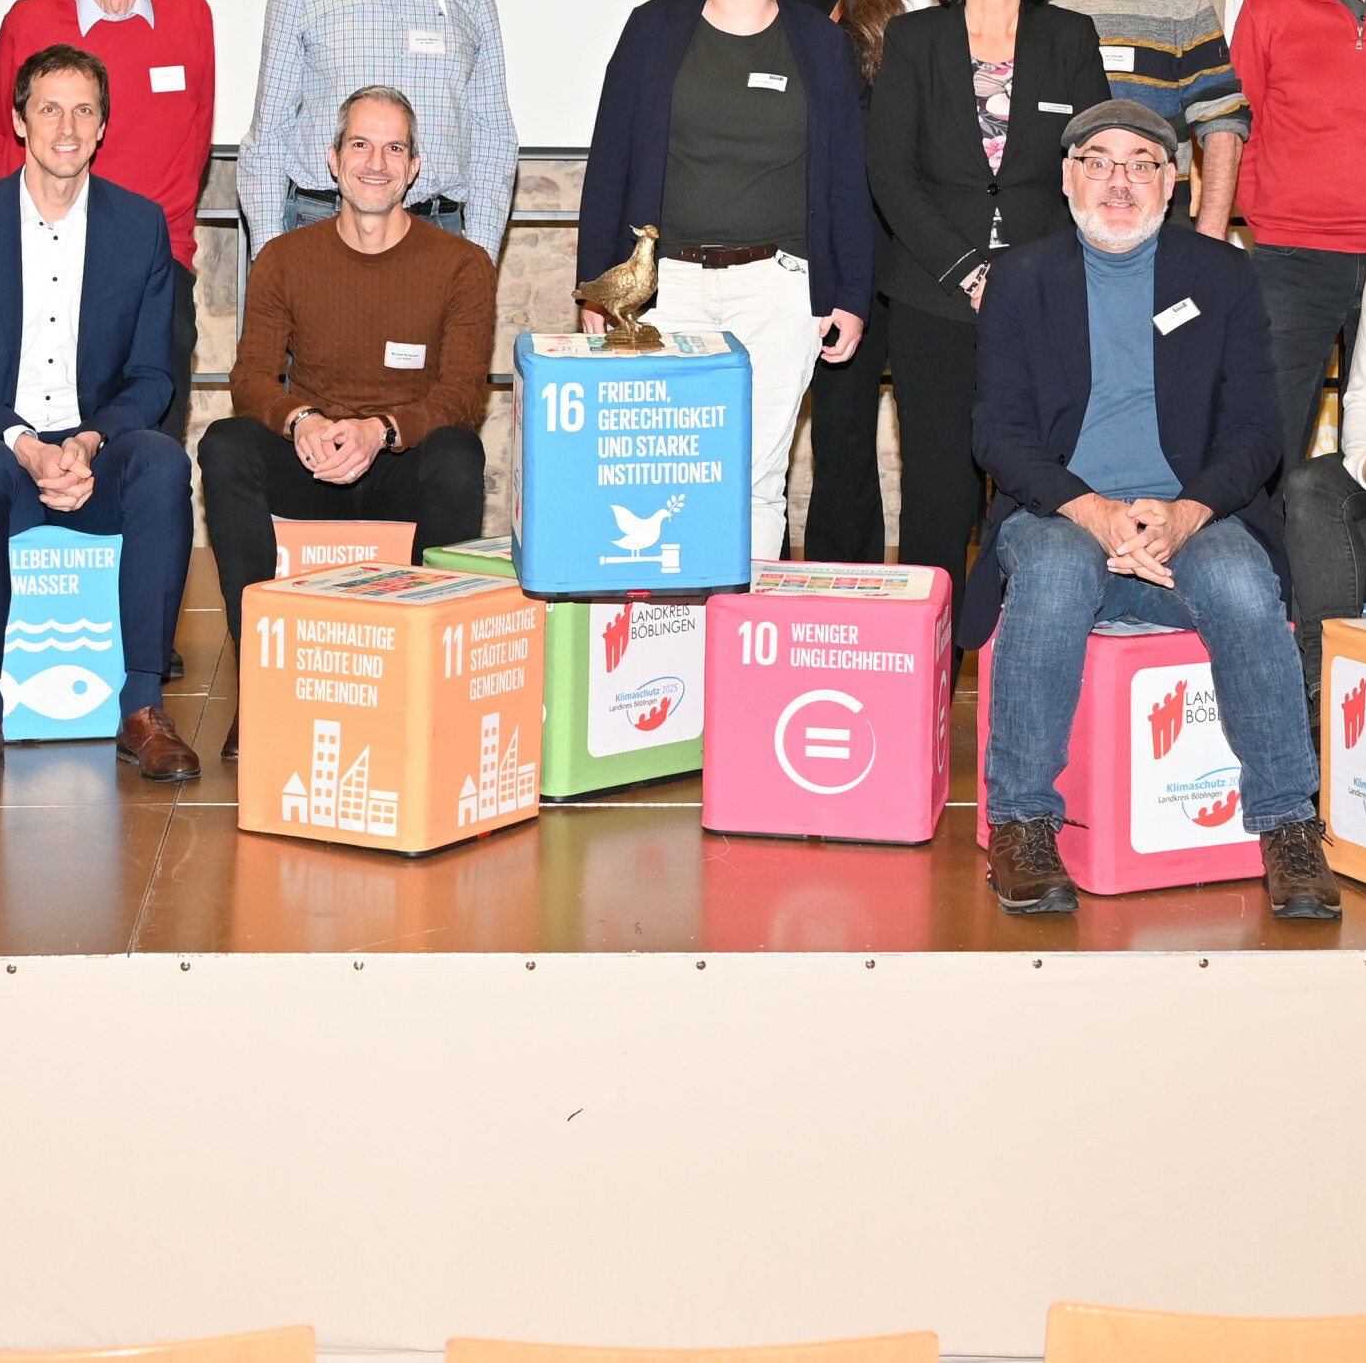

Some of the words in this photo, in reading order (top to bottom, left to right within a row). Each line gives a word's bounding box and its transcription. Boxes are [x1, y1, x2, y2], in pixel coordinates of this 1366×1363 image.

[598, 380, 671, 403] FRIEDEN,
[541, 382, 585, 432] 16
[597, 406, 726, 431] GERECHTIGKEIT
[598, 435, 633, 458] UND
[636, 434, 700, 456] STARKE
[598, 461, 722, 486] INSTITUTIONEN
[12, 548, 61, 570] LEBEN
[63, 548, 115, 568] UNTER
[11, 574, 79, 595] WASSER
[471, 606, 537, 643] NACHHALTIGE
[631, 604, 690, 624] LANDKREIS
[296, 619, 395, 651] NACHHALTIGE
[631, 618, 695, 639] BÖBLINGEN
[791, 623, 858, 644] WENIGER
[256, 616, 285, 669] 11
[442, 624, 463, 679] 11
[470, 642, 507, 672] STÄDTE
[508, 638, 528, 664] UND
[738, 620, 778, 666] 10
[296, 647, 351, 672] STÄDTE
[352, 656, 383, 679] UND
[790, 648, 914, 673] UNGLEICHHEITEN
[296, 677, 378, 707] GEMEINDEN
[469, 666, 525, 701] GEMEINDEN
[615, 687, 660, 702] Klimaschutz
[662, 684, 678, 693] 2025
[609, 702, 632, 712] Landkreis
[633, 698, 657, 708] Böblingen
[1158, 794, 1189, 803] Landkreis
[1191, 790, 1223, 800] Böblingen
[1166, 779, 1226, 793] Klimaschutz
